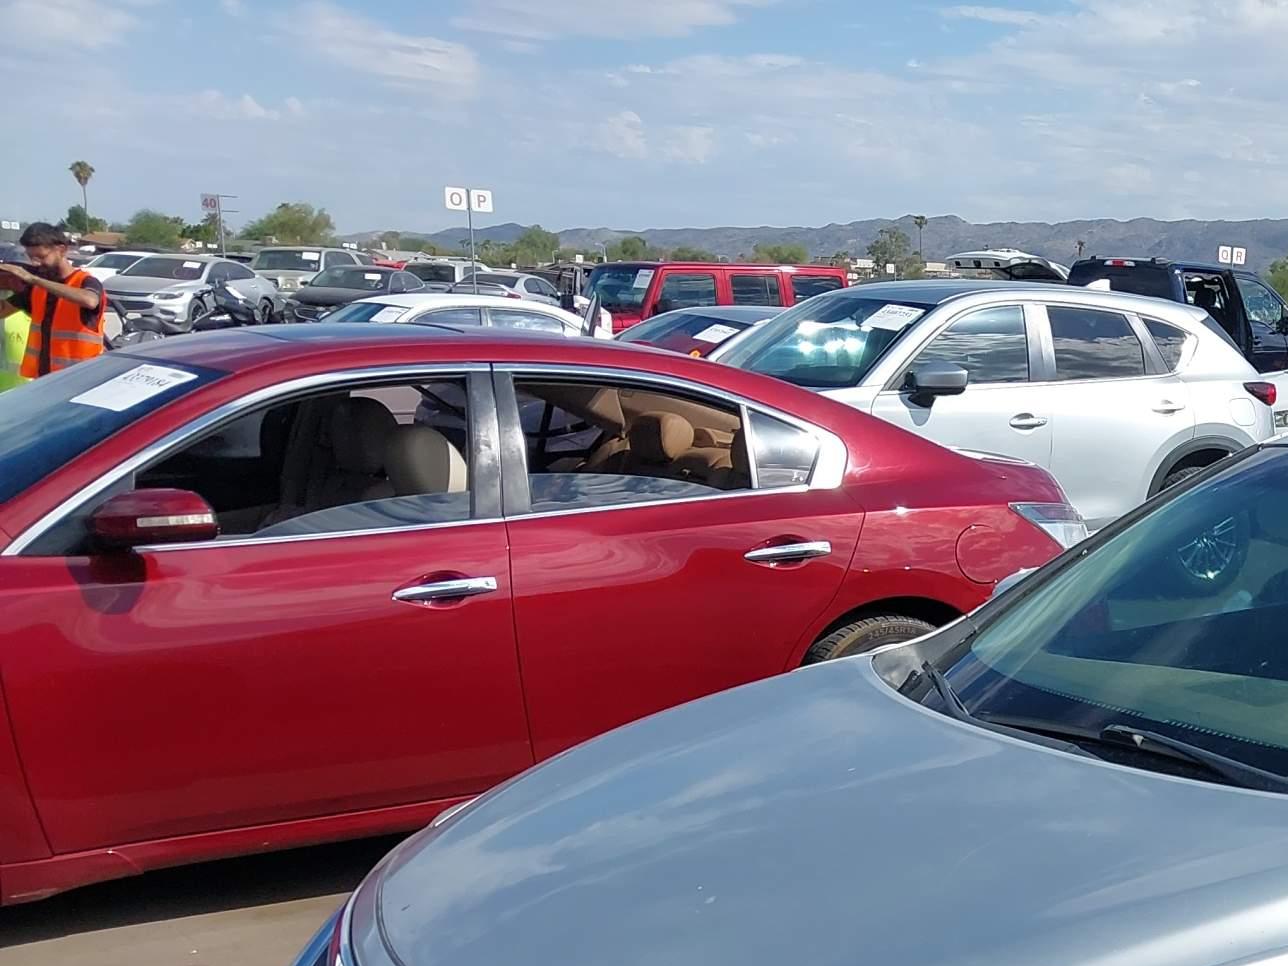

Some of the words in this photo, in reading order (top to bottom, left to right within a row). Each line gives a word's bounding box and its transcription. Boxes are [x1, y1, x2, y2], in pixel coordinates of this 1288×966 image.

[202, 197, 217, 208] 40
[450, 192, 462, 206] O
[477, 194, 487, 208] P
[1236, 250, 1243, 262] R
